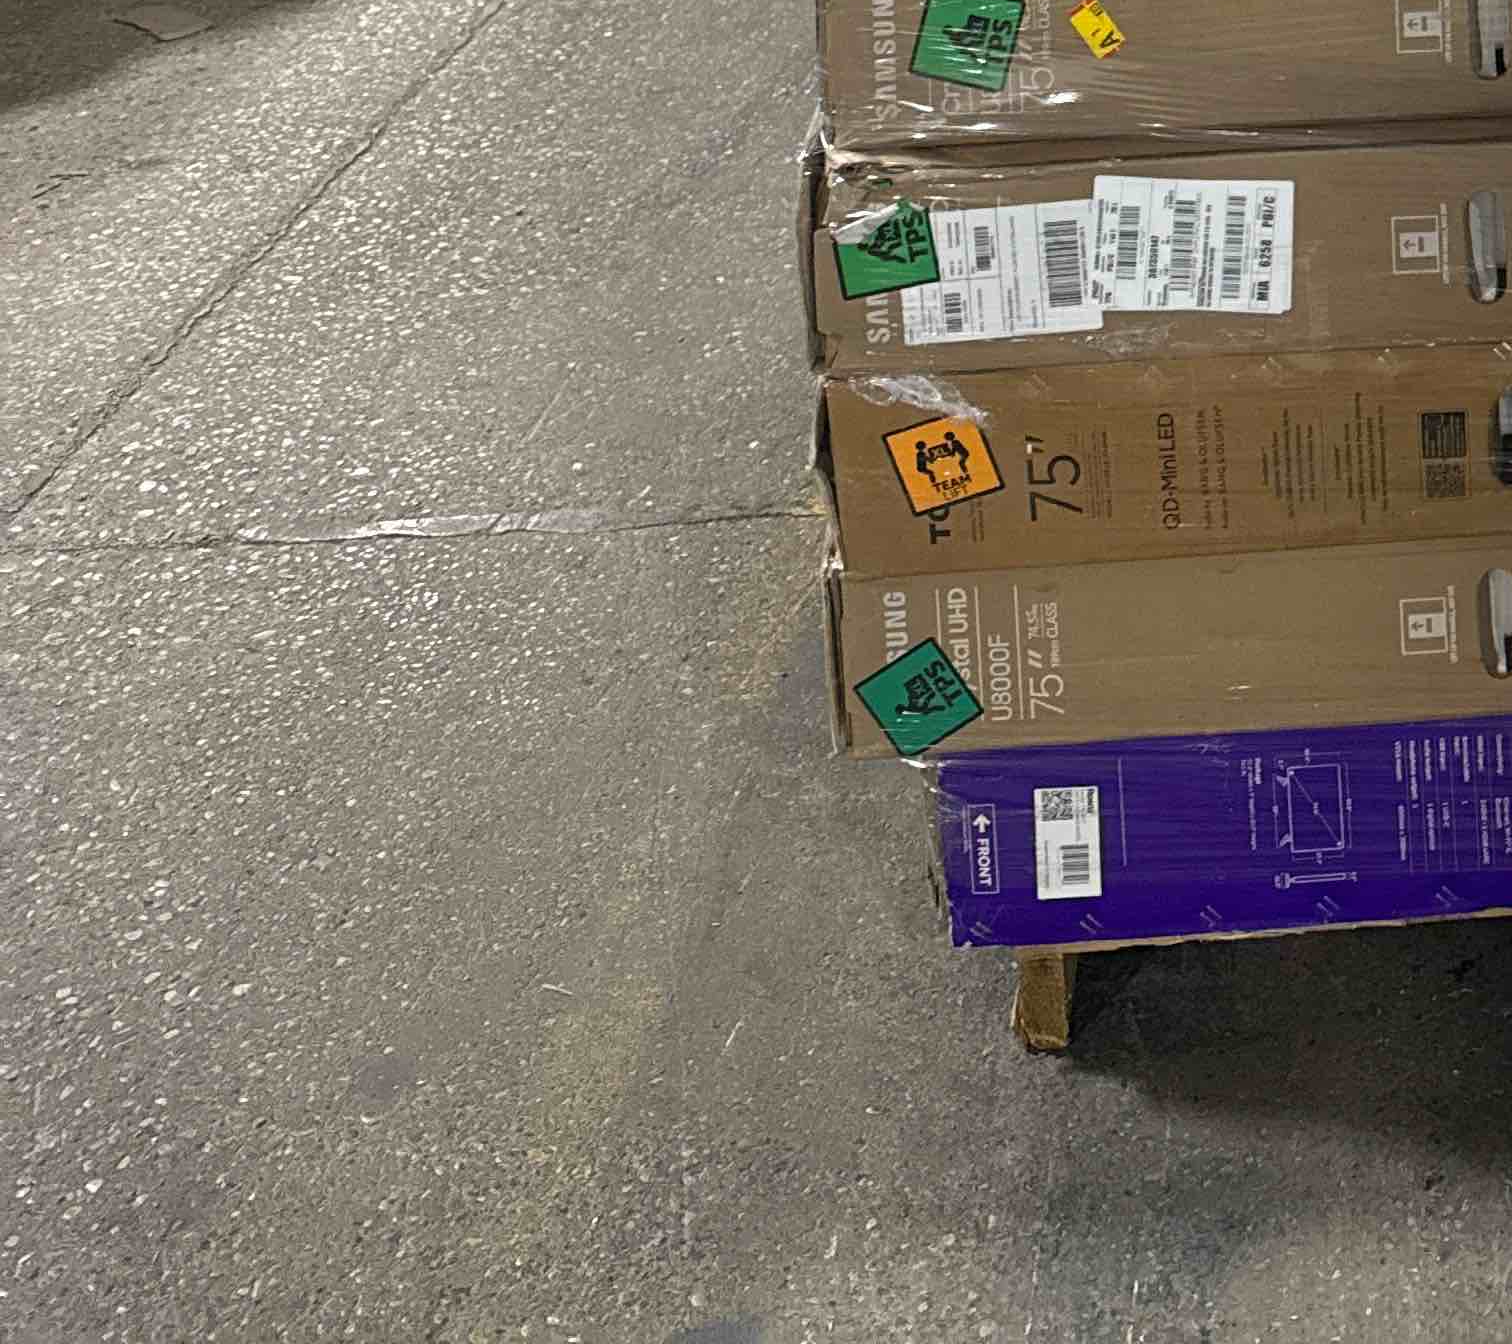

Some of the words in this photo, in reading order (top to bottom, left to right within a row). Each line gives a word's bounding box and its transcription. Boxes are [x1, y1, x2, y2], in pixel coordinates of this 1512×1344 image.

[987, 18, 1012, 64] TPS
[901, 211, 929, 263] TPS
[1255, 280, 1271, 301] MIA
[931, 473, 972, 495] TEAM
[946, 587, 969, 634] UHD
[1044, 601, 1060, 639] CLASS
[923, 659, 964, 708] TPS
[987, 634, 1014, 721] U8000F
[976, 836, 993, 887] FRONT
